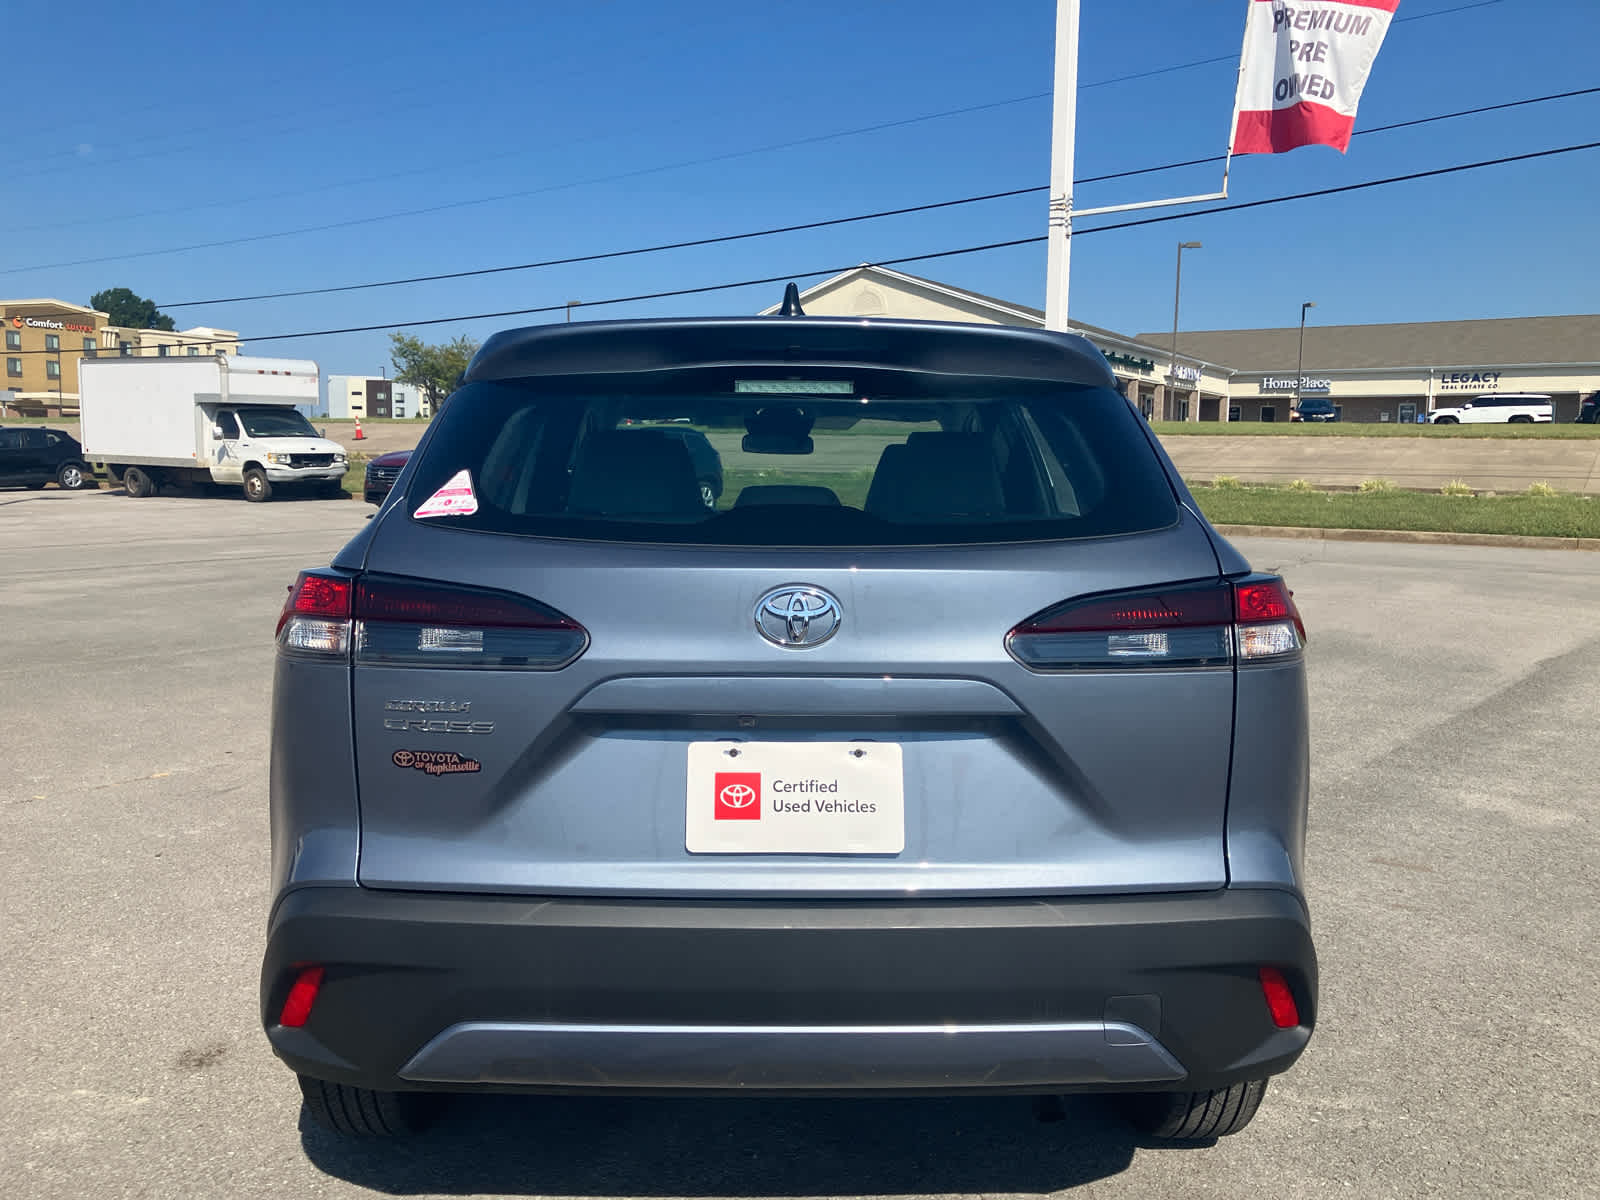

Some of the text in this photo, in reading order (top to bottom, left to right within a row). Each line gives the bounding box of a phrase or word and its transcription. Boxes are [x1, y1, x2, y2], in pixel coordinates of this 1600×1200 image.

[1273, 7, 1372, 36] PREMIUM
[1290, 40, 1328, 63] PRE
[26, 317, 63, 330] Comfort
[1441, 372, 1501, 384] LEGACY
[384, 719, 495, 734] CROSS
[414, 751, 460, 763] TOYOTA
[772, 779, 838, 794] Certified
[772, 799, 877, 813] Used Vehicles
